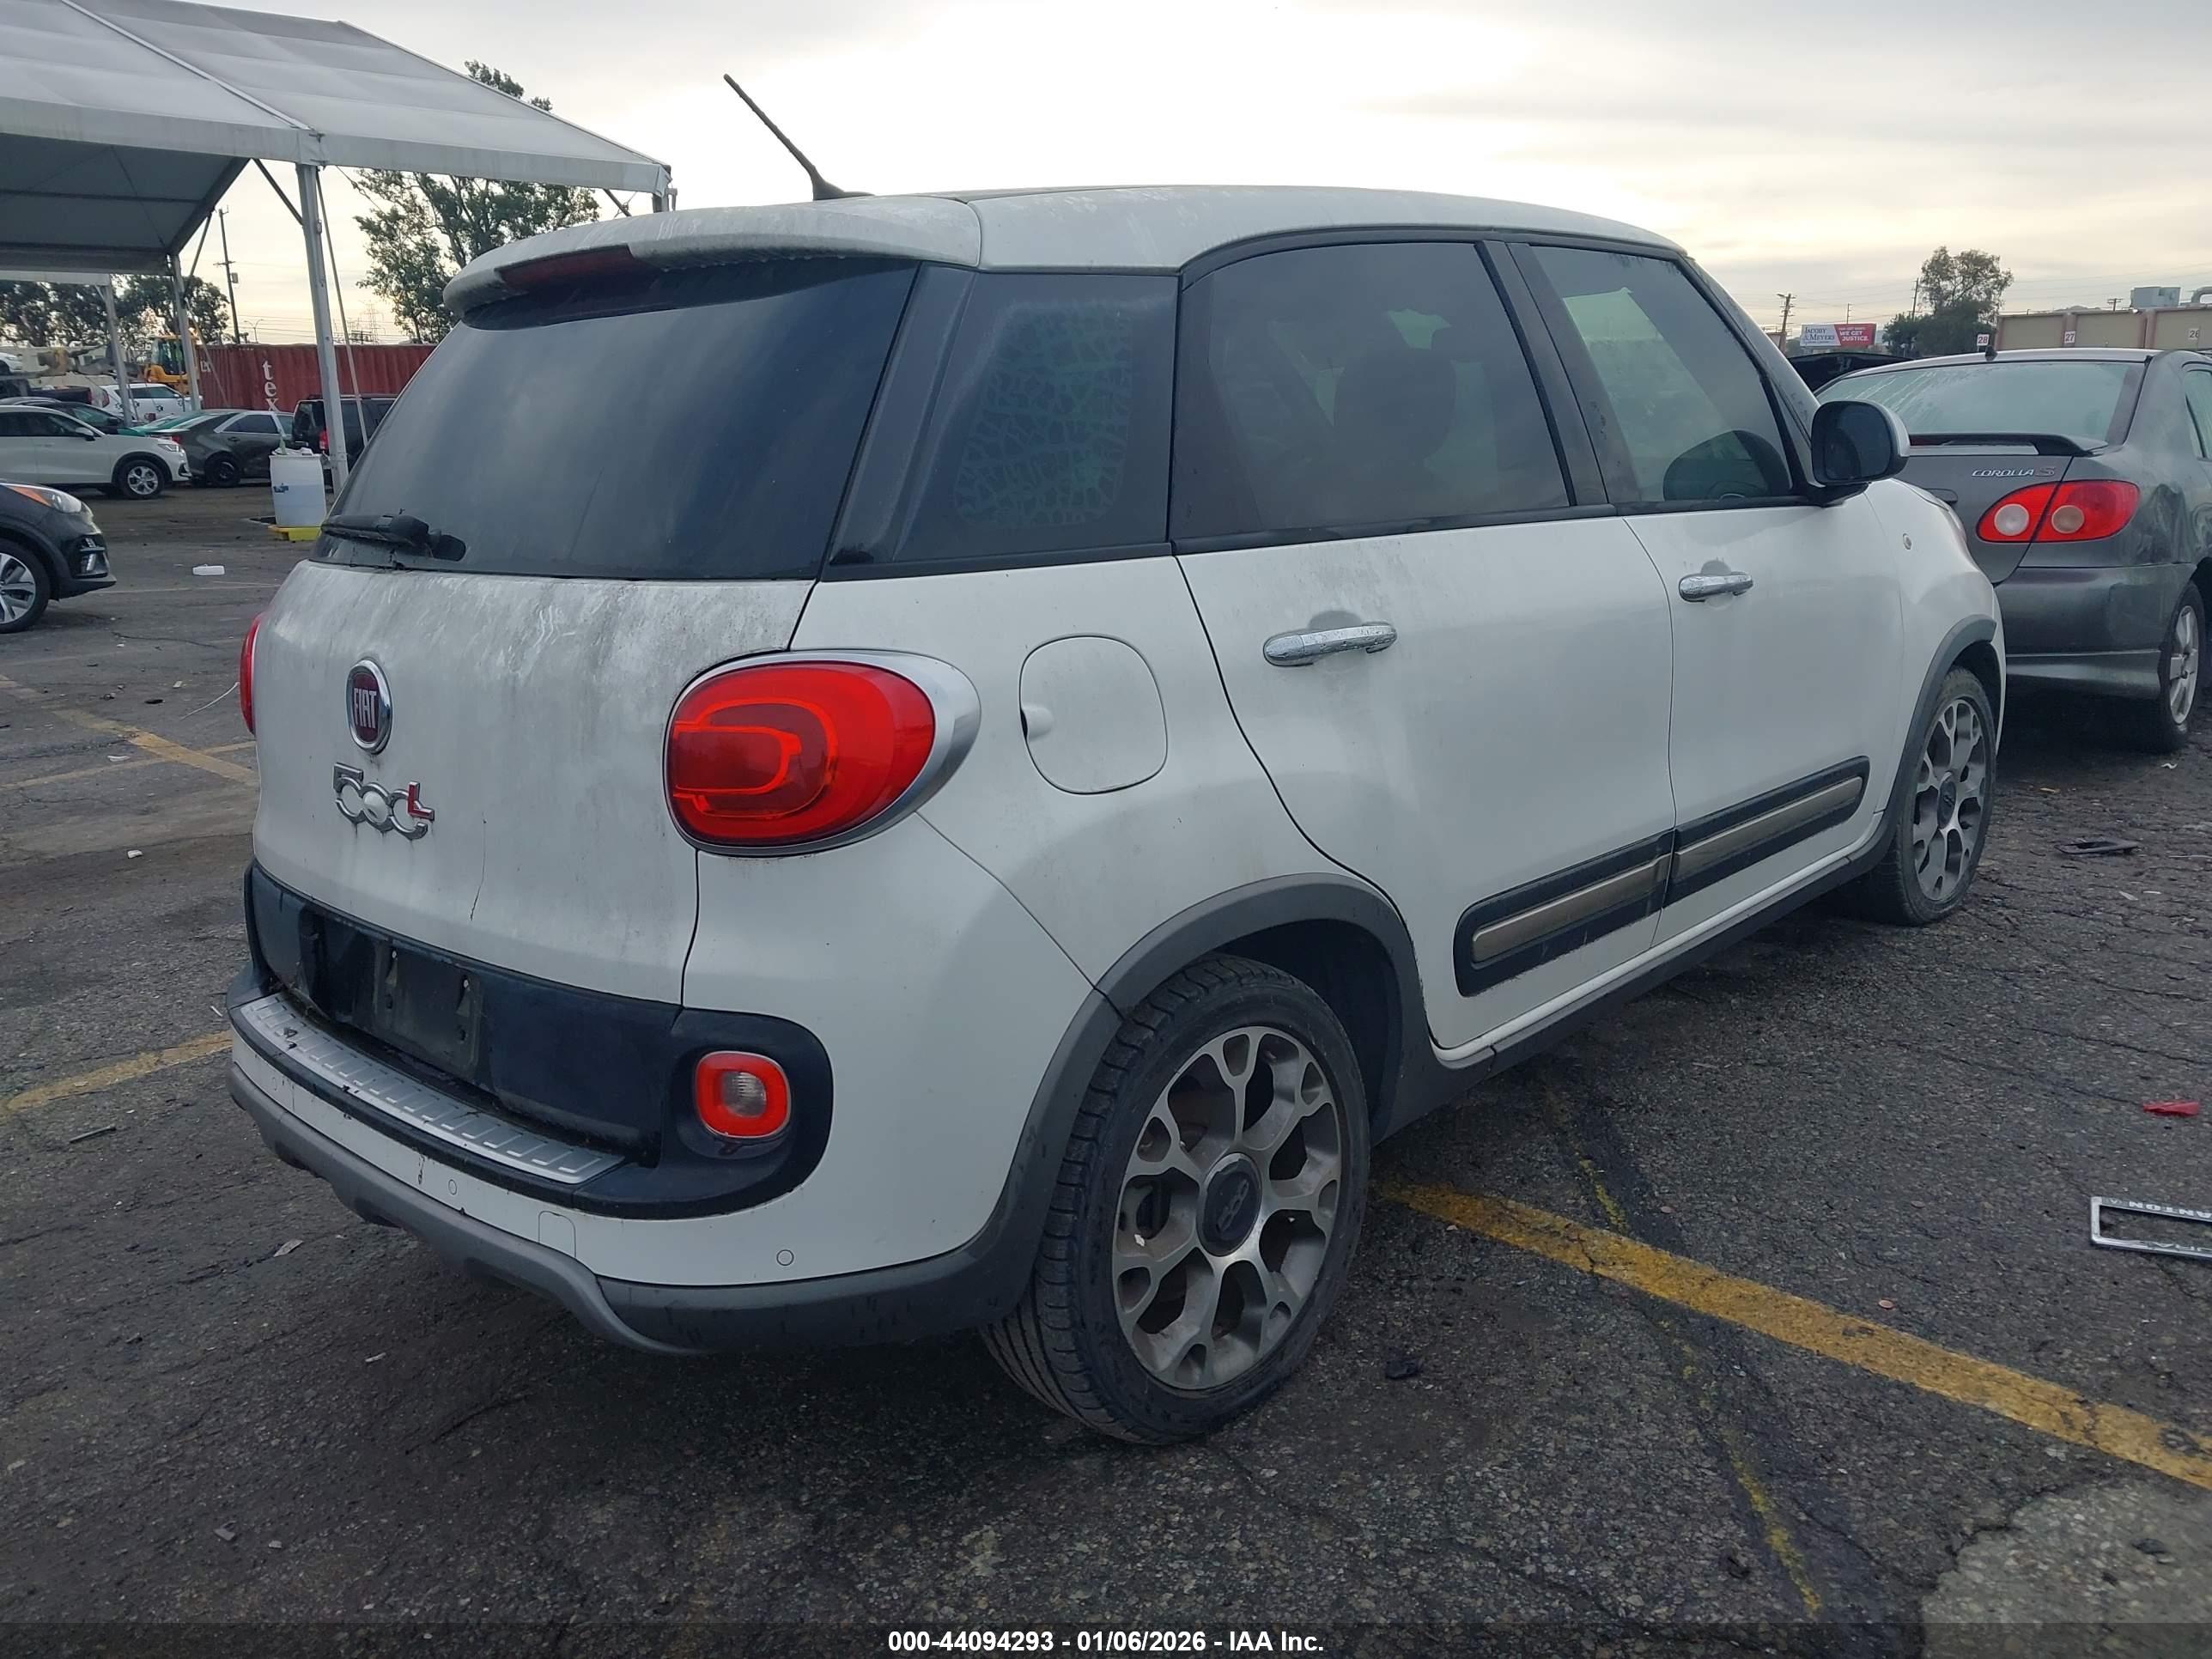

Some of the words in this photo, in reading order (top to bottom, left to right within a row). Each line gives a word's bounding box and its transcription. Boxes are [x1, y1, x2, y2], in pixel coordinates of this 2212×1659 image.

[2065, 333, 2075, 342] 27
[1972, 469, 2034, 477] COROLLA
[353, 687, 377, 729] FIAT
